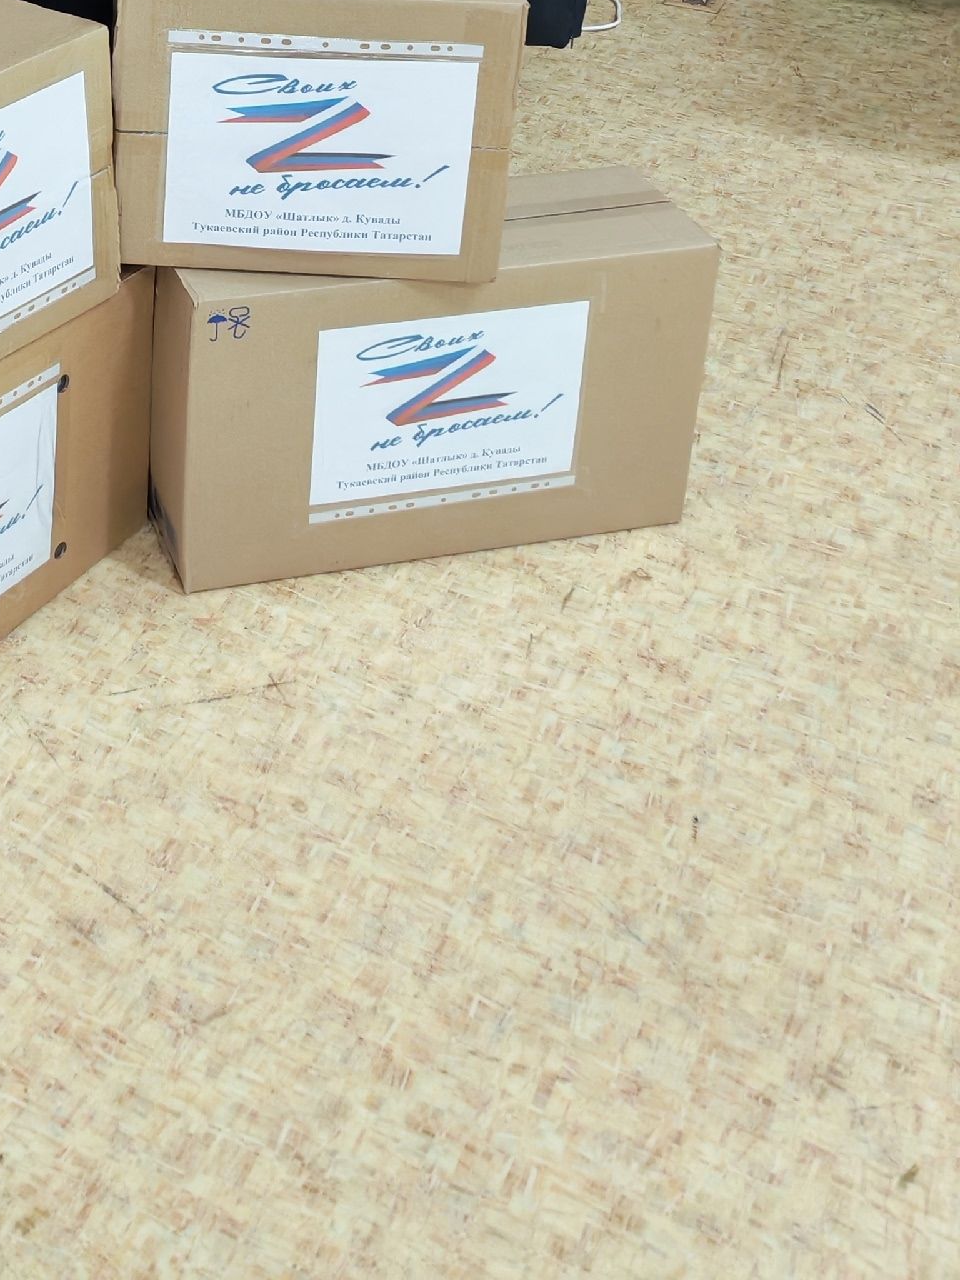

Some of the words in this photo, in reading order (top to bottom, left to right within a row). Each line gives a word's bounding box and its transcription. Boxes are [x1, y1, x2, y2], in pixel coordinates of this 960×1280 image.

[212, 73, 358, 95] Своих
[229, 182, 265, 198] не
[276, 165, 451, 201] бросаем!
[225, 208, 273, 220] МБДОУ
[356, 214, 401, 226] Кувады
[192, 222, 260, 236] Тукаевский
[262, 227, 297, 238] район
[300, 228, 369, 241] Республики
[373, 230, 432, 243] Татарстан
[33, 256, 74, 284] Татарстан
[356, 330, 485, 361] Своих
[370, 435, 402, 451] не
[412, 393, 564, 448] бросаем!
[337, 473, 398, 491] Тукаевский
[400, 470, 430, 483] район
[433, 463, 492, 478] Республики
[496, 456, 548, 469] Татарстан
[366, 459, 410, 472] МБДОУ
